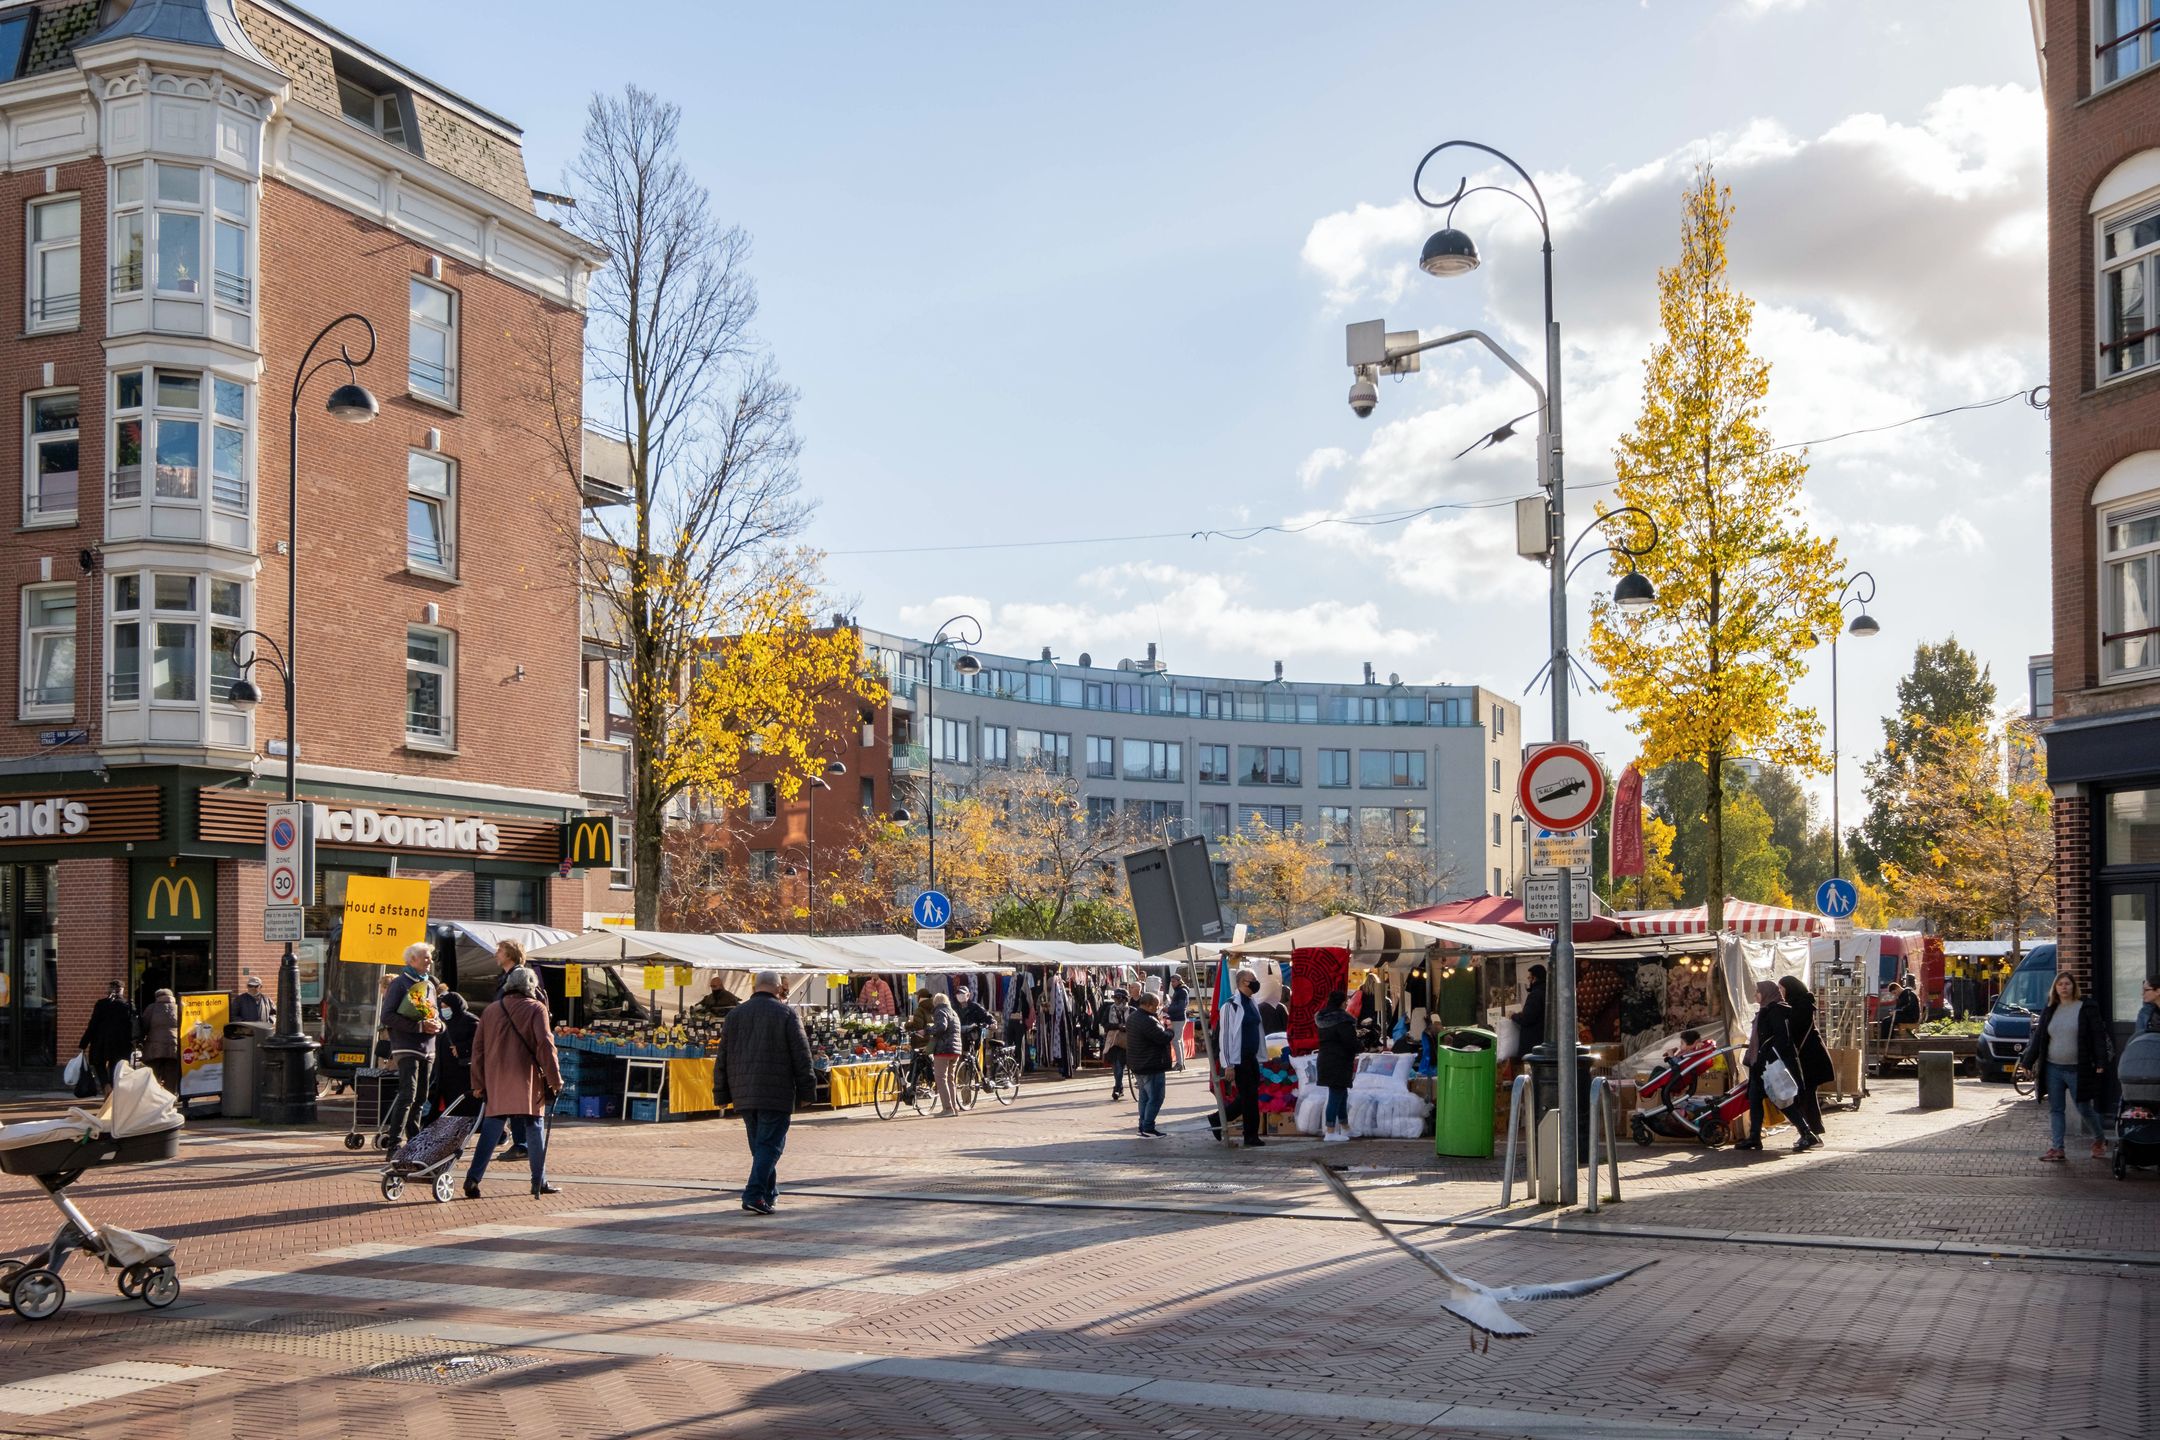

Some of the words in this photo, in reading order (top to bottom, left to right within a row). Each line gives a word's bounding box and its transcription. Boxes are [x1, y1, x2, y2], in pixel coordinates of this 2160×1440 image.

[1544, 786, 1554, 794] ALC
[0, 797, 89, 838] ald's
[275, 876, 291, 889] 30
[1541, 883, 1555, 891] t/m
[345, 900, 376, 914] Houd
[379, 904, 426, 918] afstand
[368, 923, 383, 936] 1.5
[387, 927, 397, 936] m
